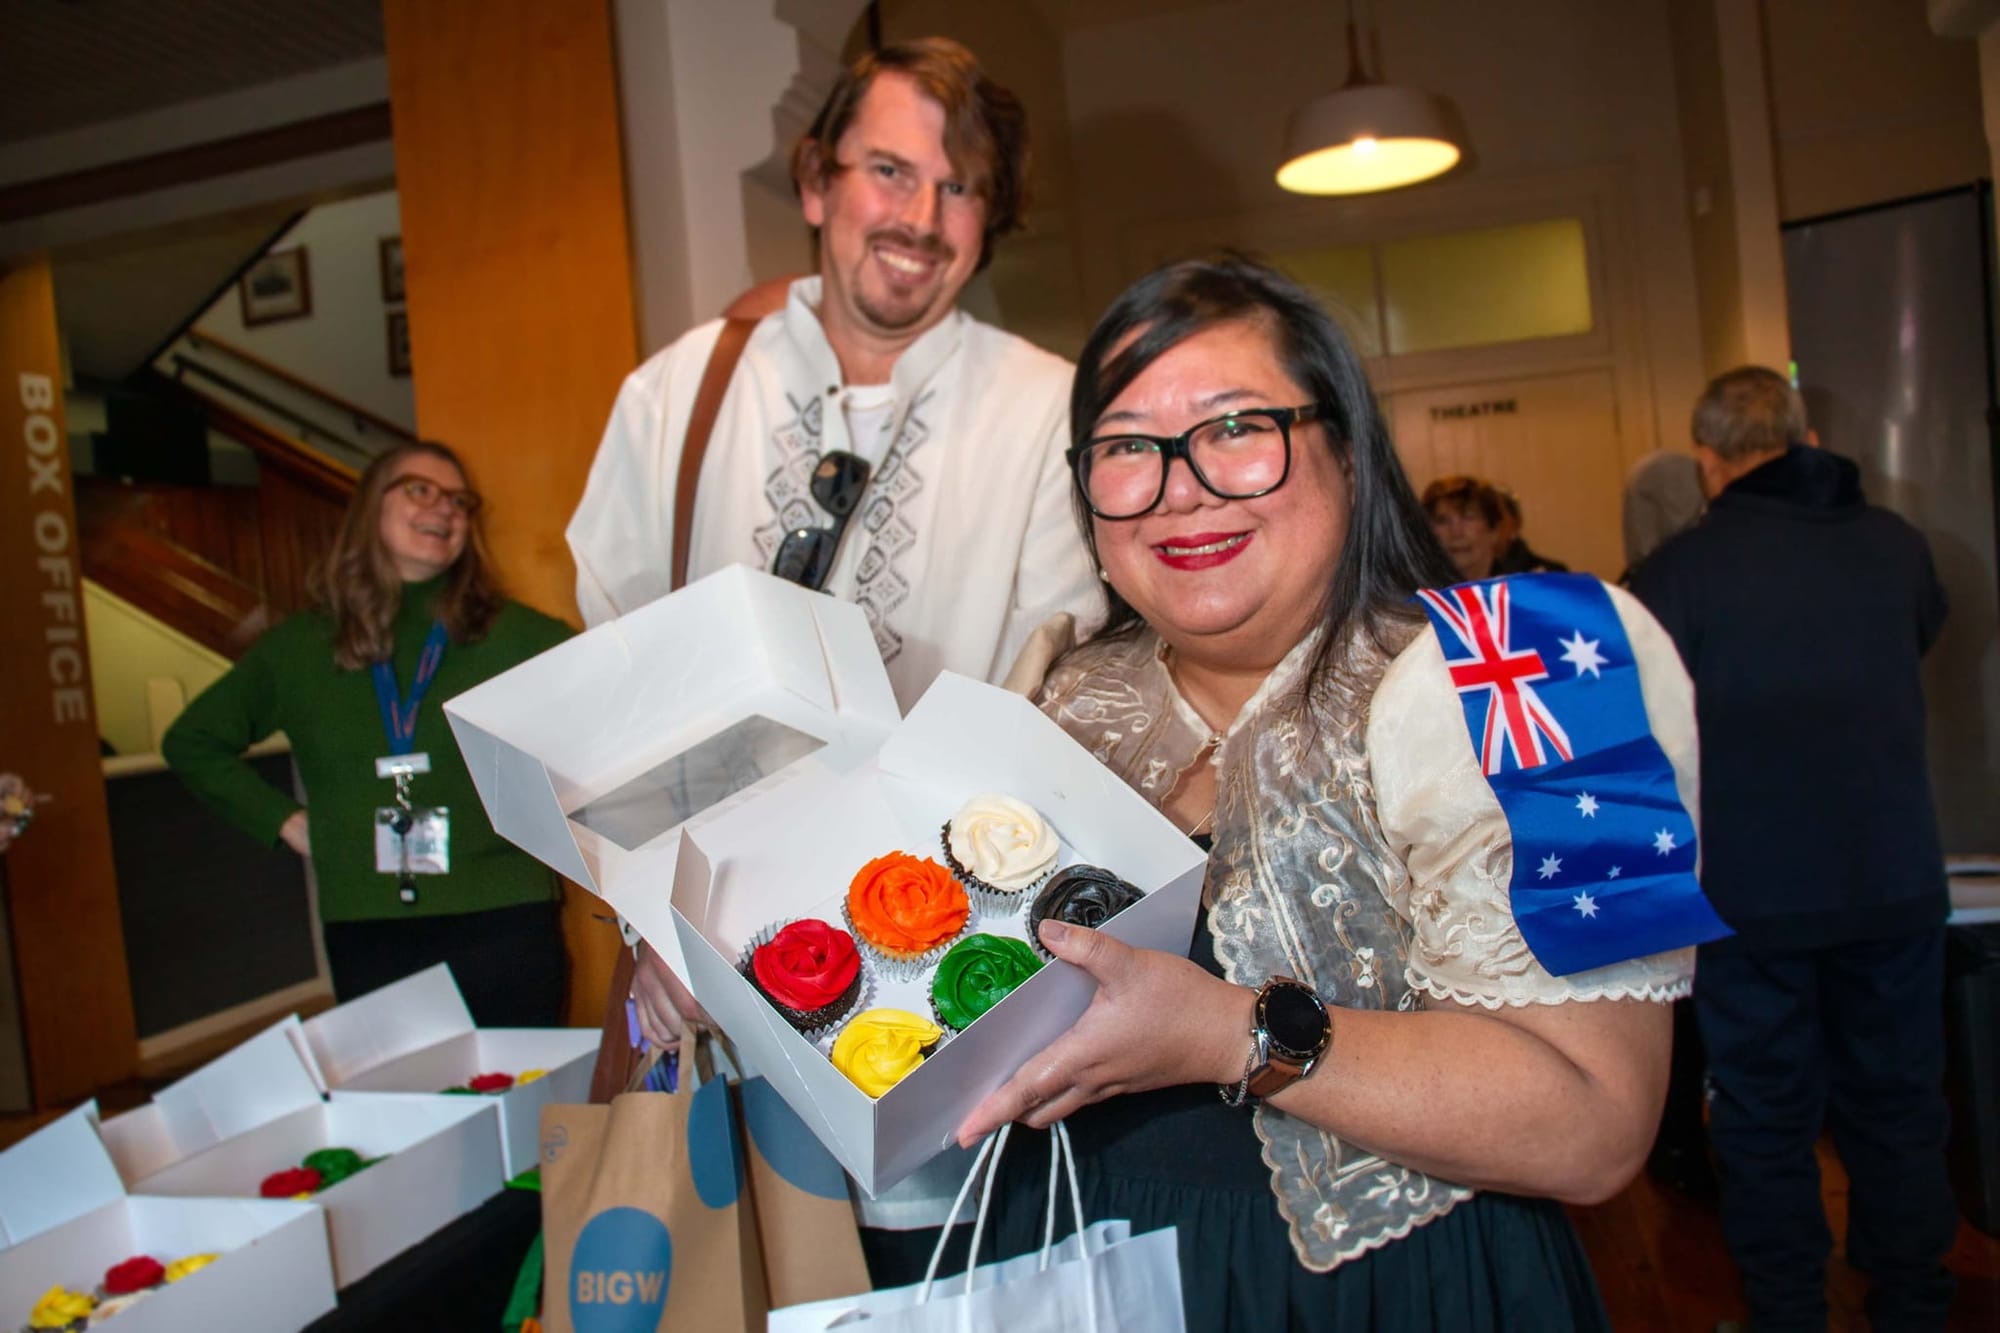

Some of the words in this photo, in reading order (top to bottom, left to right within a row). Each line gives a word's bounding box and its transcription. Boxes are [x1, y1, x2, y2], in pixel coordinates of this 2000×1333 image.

[19, 372, 63, 494] BOX
[1429, 399, 1517, 420] THEATRE
[34, 510, 87, 724] OFFICE
